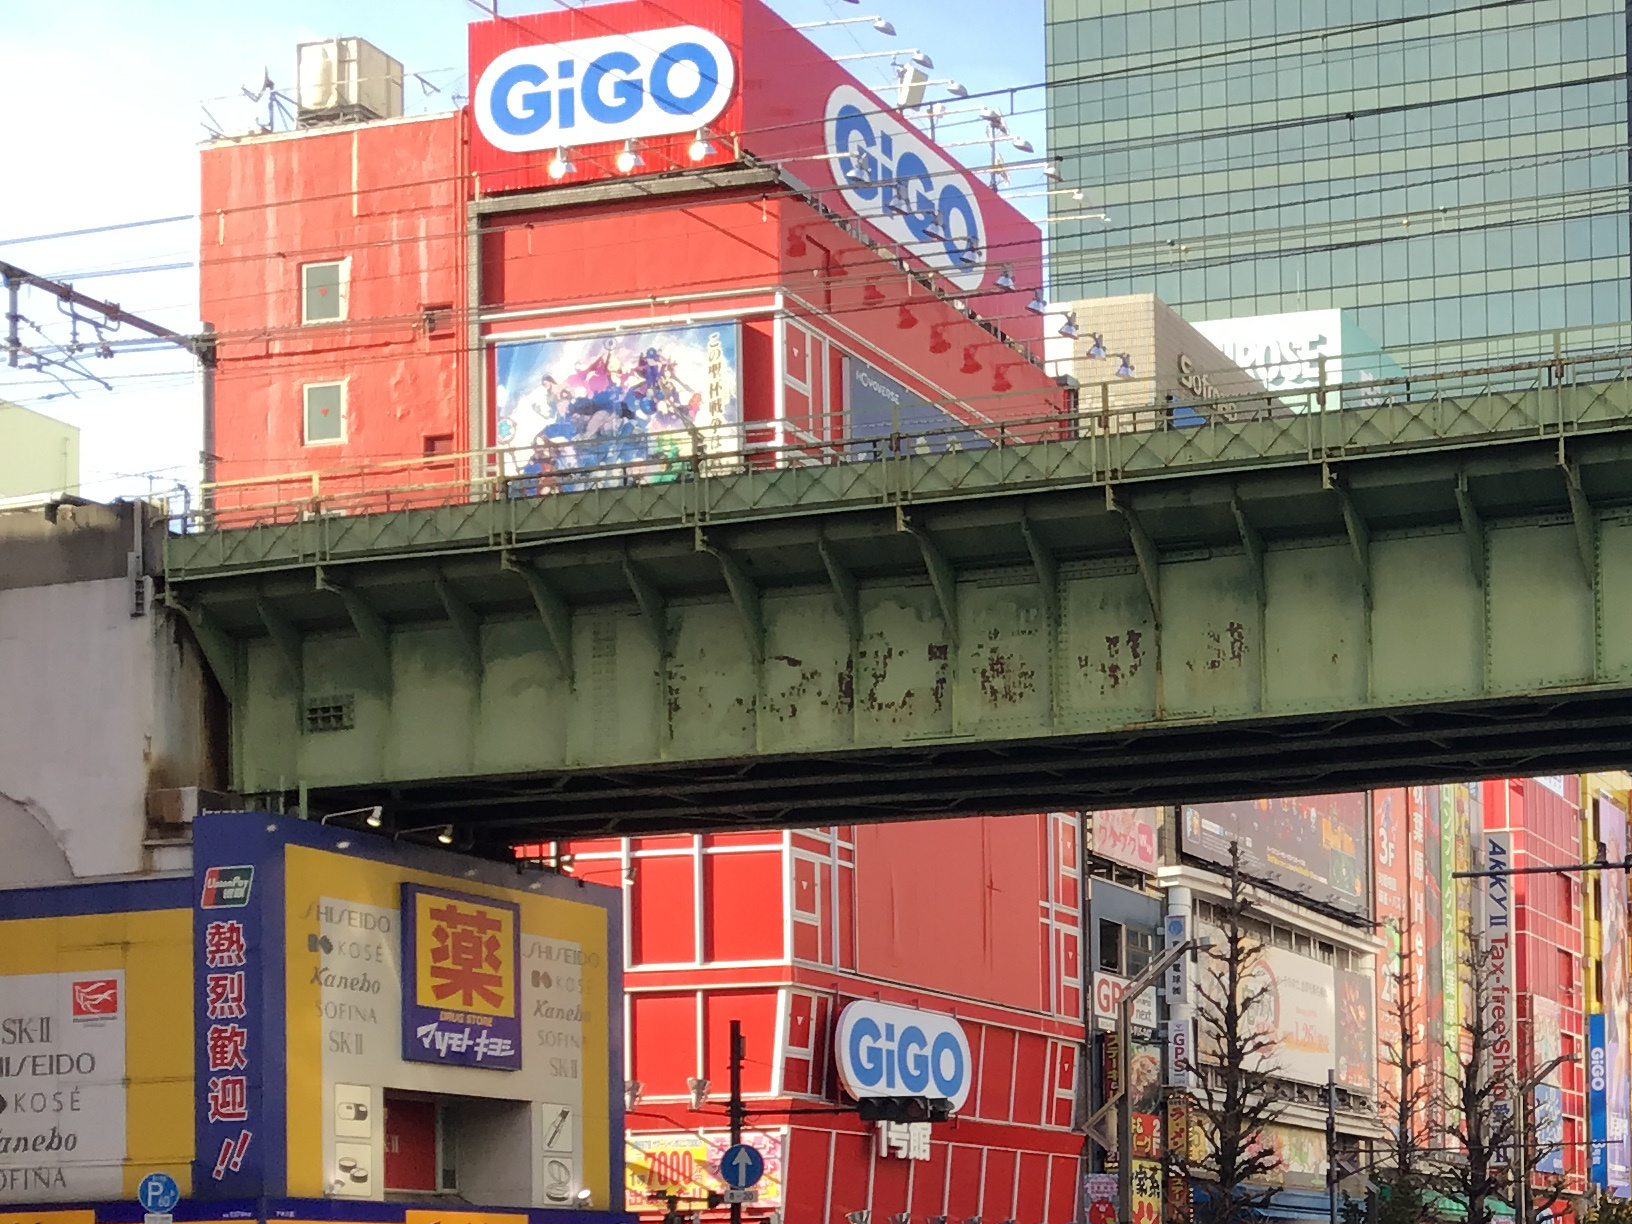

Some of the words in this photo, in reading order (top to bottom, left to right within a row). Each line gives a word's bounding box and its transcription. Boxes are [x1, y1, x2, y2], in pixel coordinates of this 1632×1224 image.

[490, 42, 719, 136] GiGO
[835, 104, 977, 273] GiGO
[1378, 827, 1395, 867] 3F
[1488, 838, 1508, 912] AKKY
[300, 902, 391, 934] SHISEIDO
[338, 940, 383, 963] KOSÉ
[429, 904, 505, 1009] 薬
[523, 943, 600, 968] SHISEIDO
[310, 966, 382, 994] Kanebo
[1097, 978, 1134, 1019] GP
[1490, 932, 1510, 1034] Tax-free
[316, 1001, 378, 1024] SOFINA
[440, 1011, 464, 1023] DRUG
[466, 1015, 493, 1027] STORE
[533, 1000, 591, 1023] Kanebo
[849, 1017, 964, 1098] GiGO
[1173, 1033, 1187, 1072] GPS
[1590, 1047, 1605, 1091] GiGO
[14, 1086, 81, 1113] KOSÉ
[0, 1126, 78, 1153] anebo
[877, 1120, 932, 1161] 1号館
[645, 1150, 693, 1186] 7000
[148, 1181, 164, 1206] P
